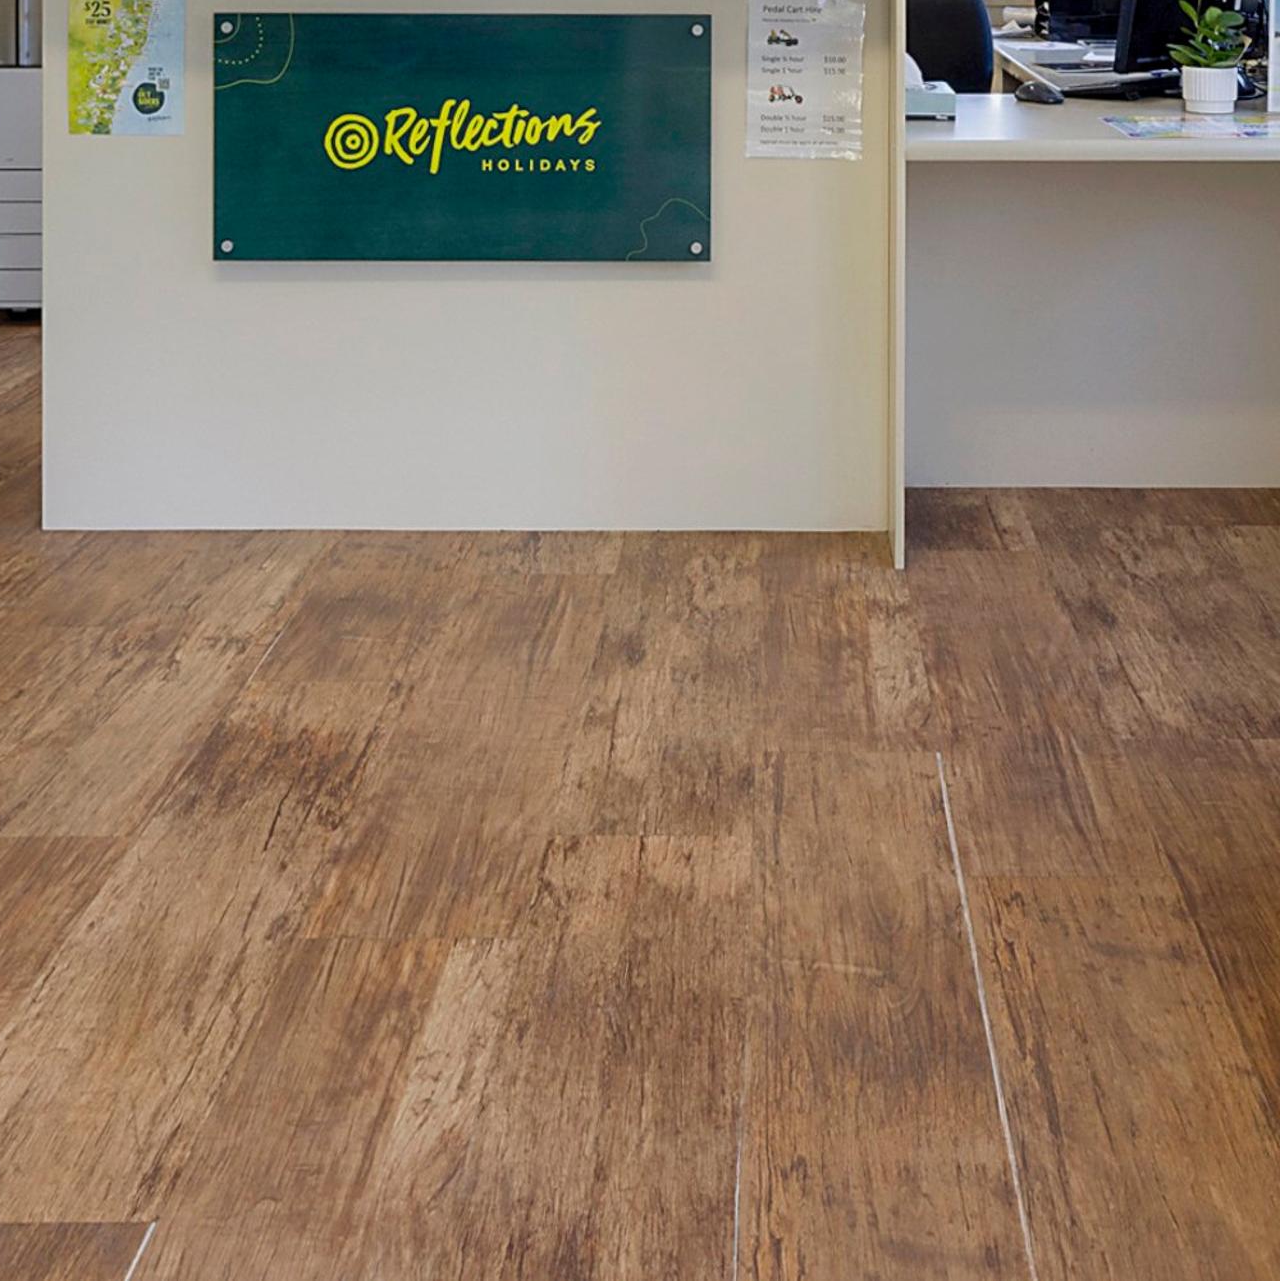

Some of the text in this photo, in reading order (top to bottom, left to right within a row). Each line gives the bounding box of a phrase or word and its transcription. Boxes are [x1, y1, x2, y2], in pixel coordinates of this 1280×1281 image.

[762, 5, 785, 13] Pedal
[787, 5, 804, 13] Cart
[383, 99, 602, 174] Reflections
[481, 158, 597, 172] HOLIDAYS
